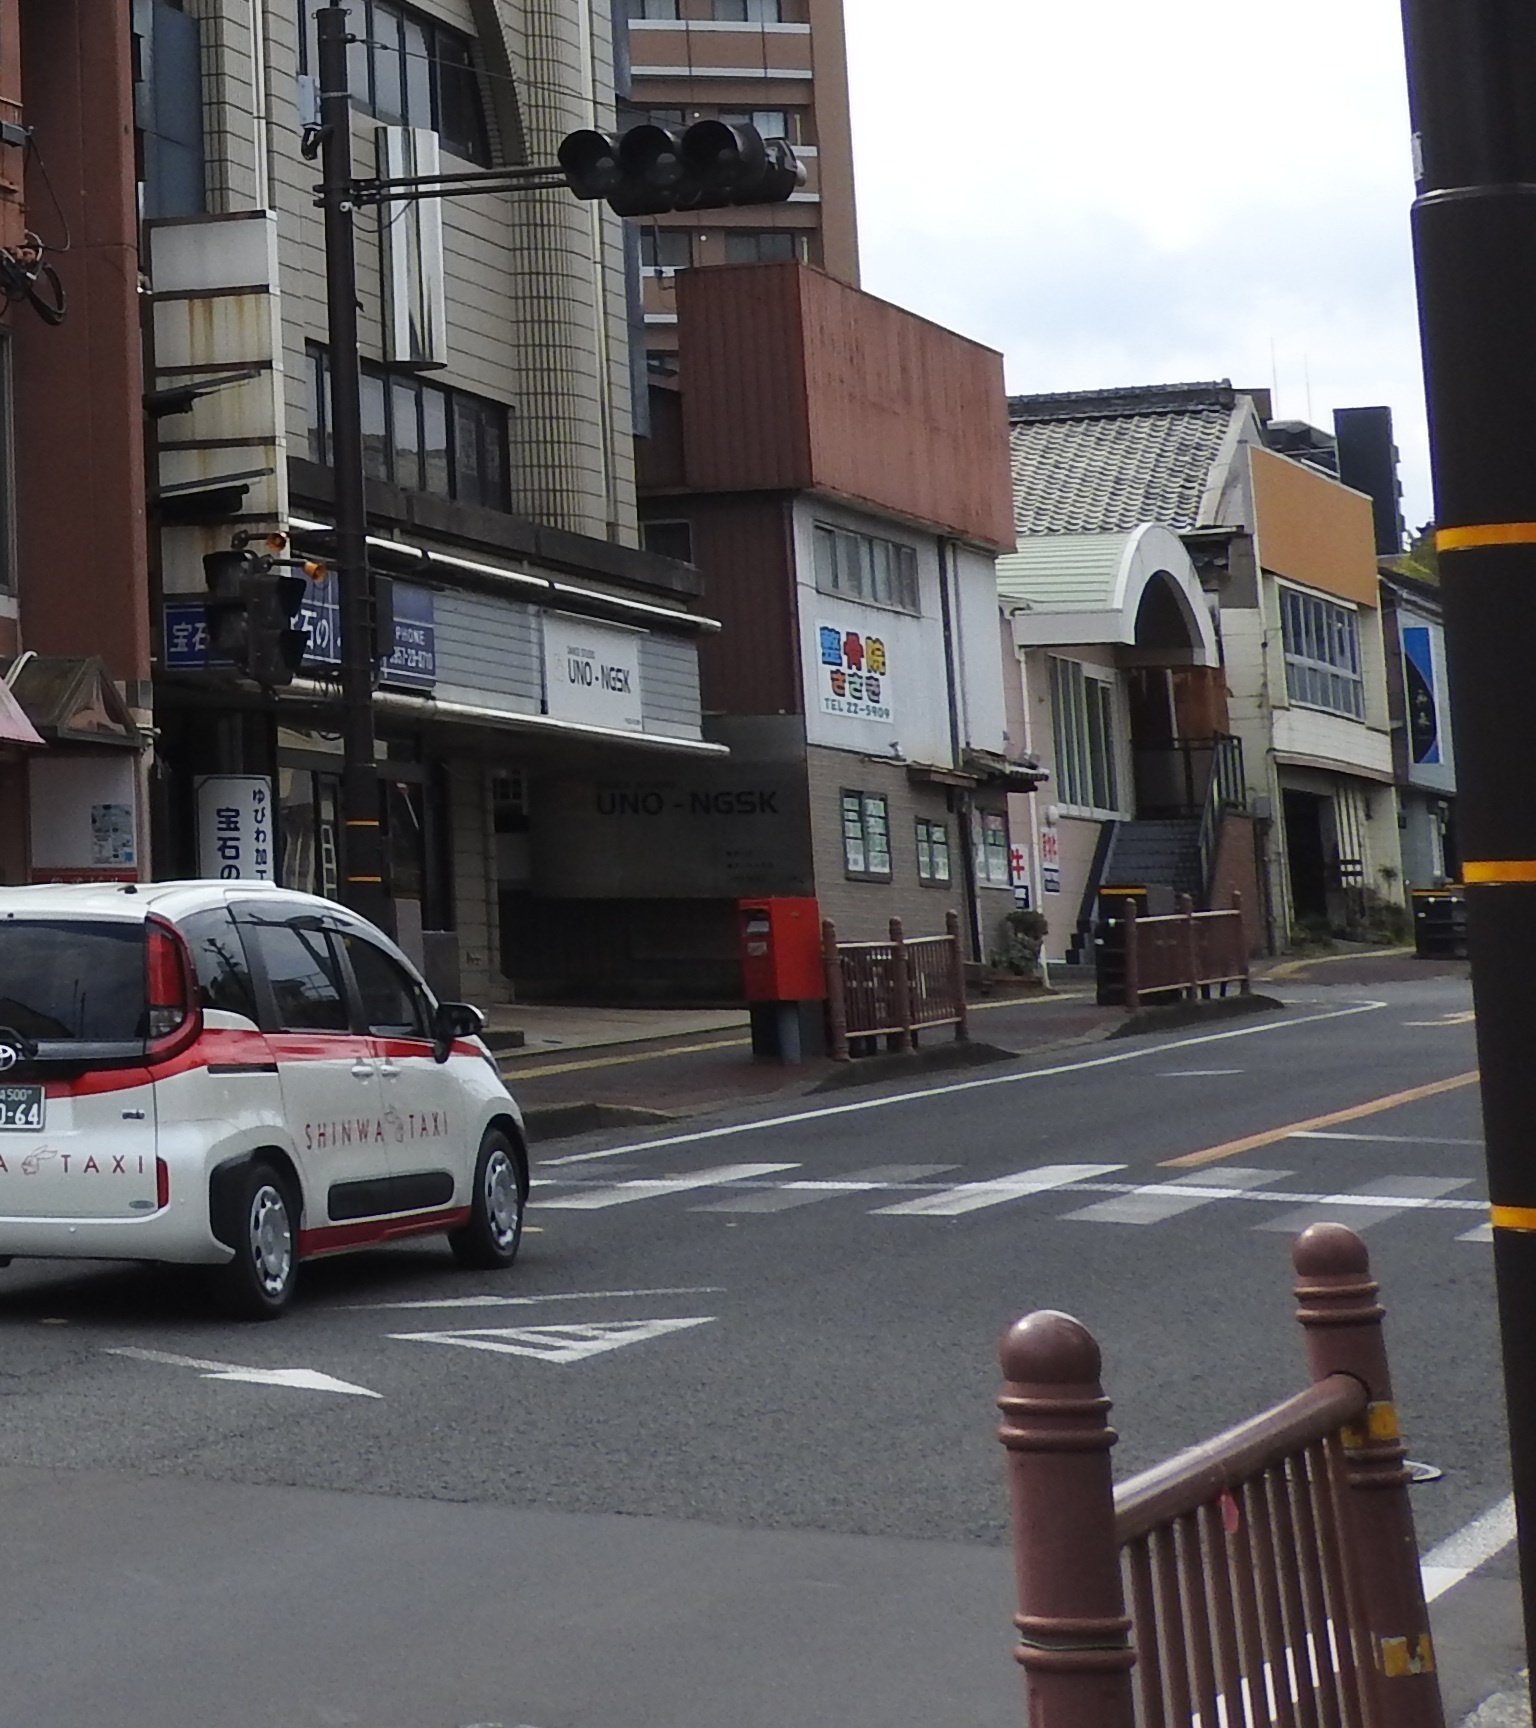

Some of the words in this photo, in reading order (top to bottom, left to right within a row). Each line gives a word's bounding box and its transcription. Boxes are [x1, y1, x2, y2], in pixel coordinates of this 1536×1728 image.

[395, 626, 425, 646] PHONE
[820, 626, 887, 676] 整骨院
[568, 658, 593, 687] UNO
[601, 664, 631, 694] NGSK
[824, 698, 844, 712] TEL
[597, 791, 665, 815] UNO
[689, 791, 779, 815] NGSK
[304, 1118, 385, 1150] SHINWA
[408, 1111, 448, 1139] TAXI
[60, 1154, 144, 1174] TAXI
